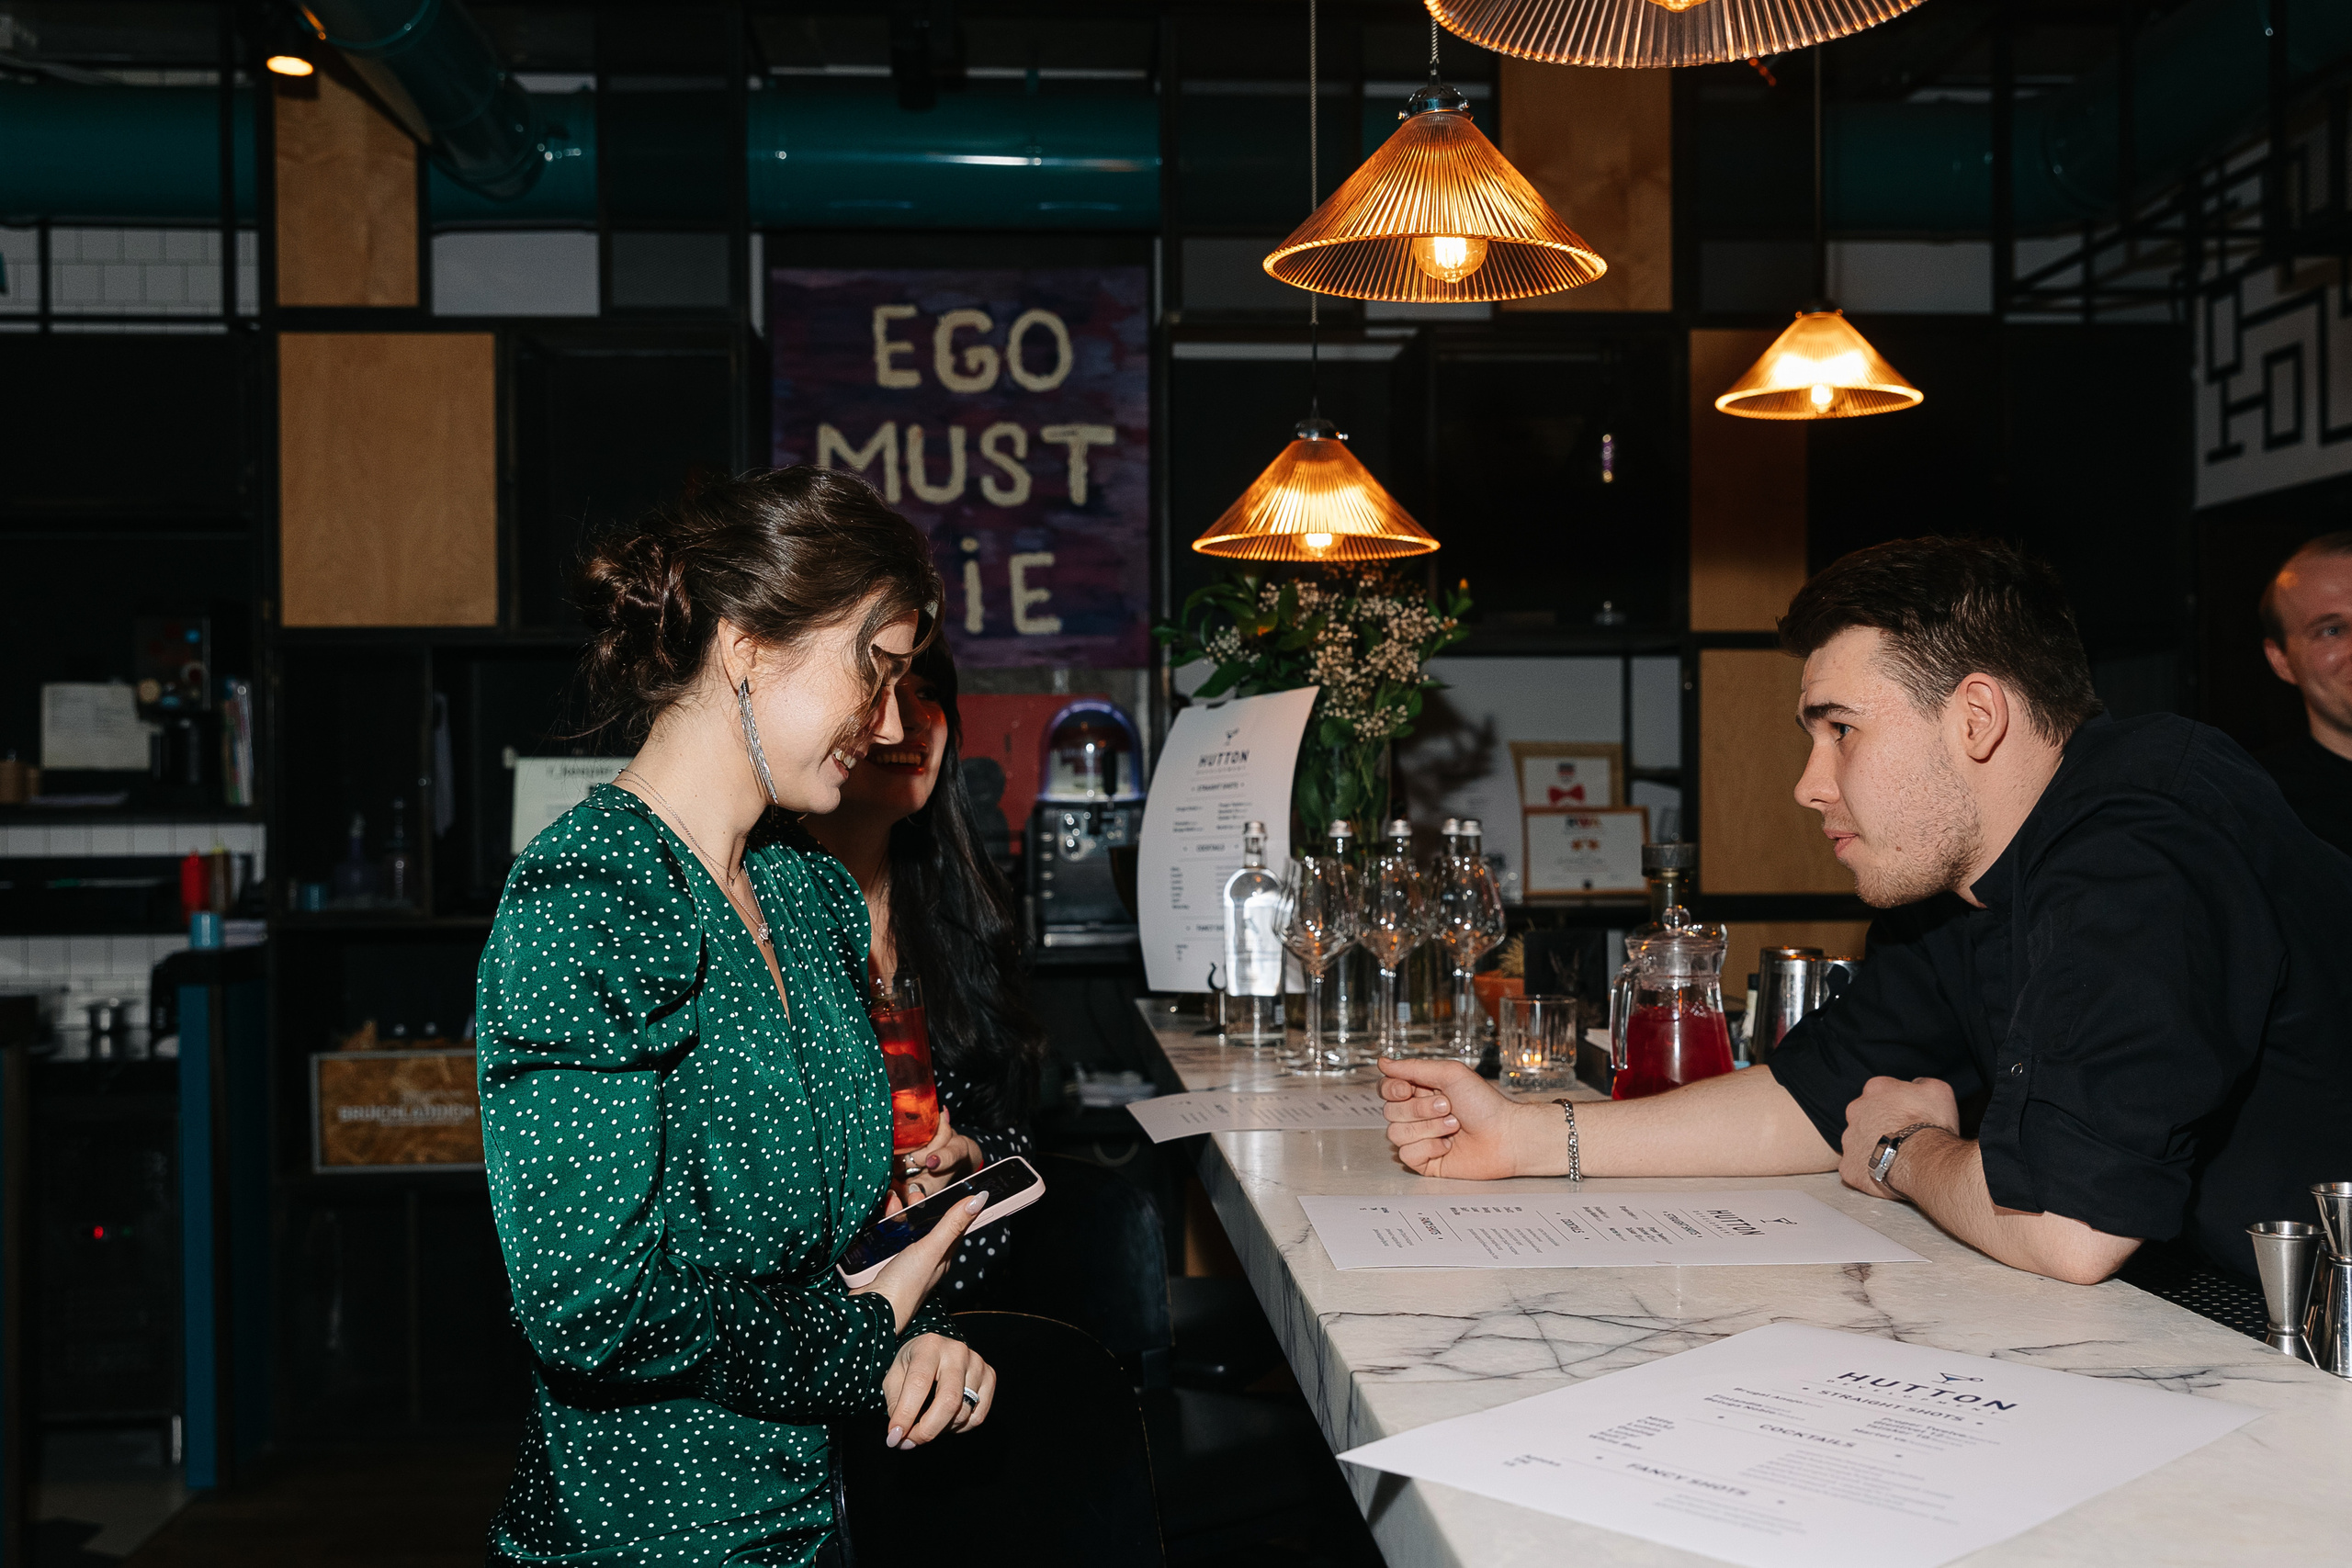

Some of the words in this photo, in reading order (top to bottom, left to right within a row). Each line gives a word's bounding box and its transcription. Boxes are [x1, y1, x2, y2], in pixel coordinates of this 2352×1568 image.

[872, 304, 1073, 393] EGO
[816, 422, 1116, 507] MUST
[1706, 1209, 1766, 1235] HUTTON
[1817, 1390, 1905, 1411] STRAIGHT
[1905, 1406, 1965, 1422] SHOTS
[1826, 1380, 1997, 1415] DEVELOPMENT
[1838, 1371, 2018, 1412] HUTTON
[1758, 1424, 1857, 1448] COCKTAILS
